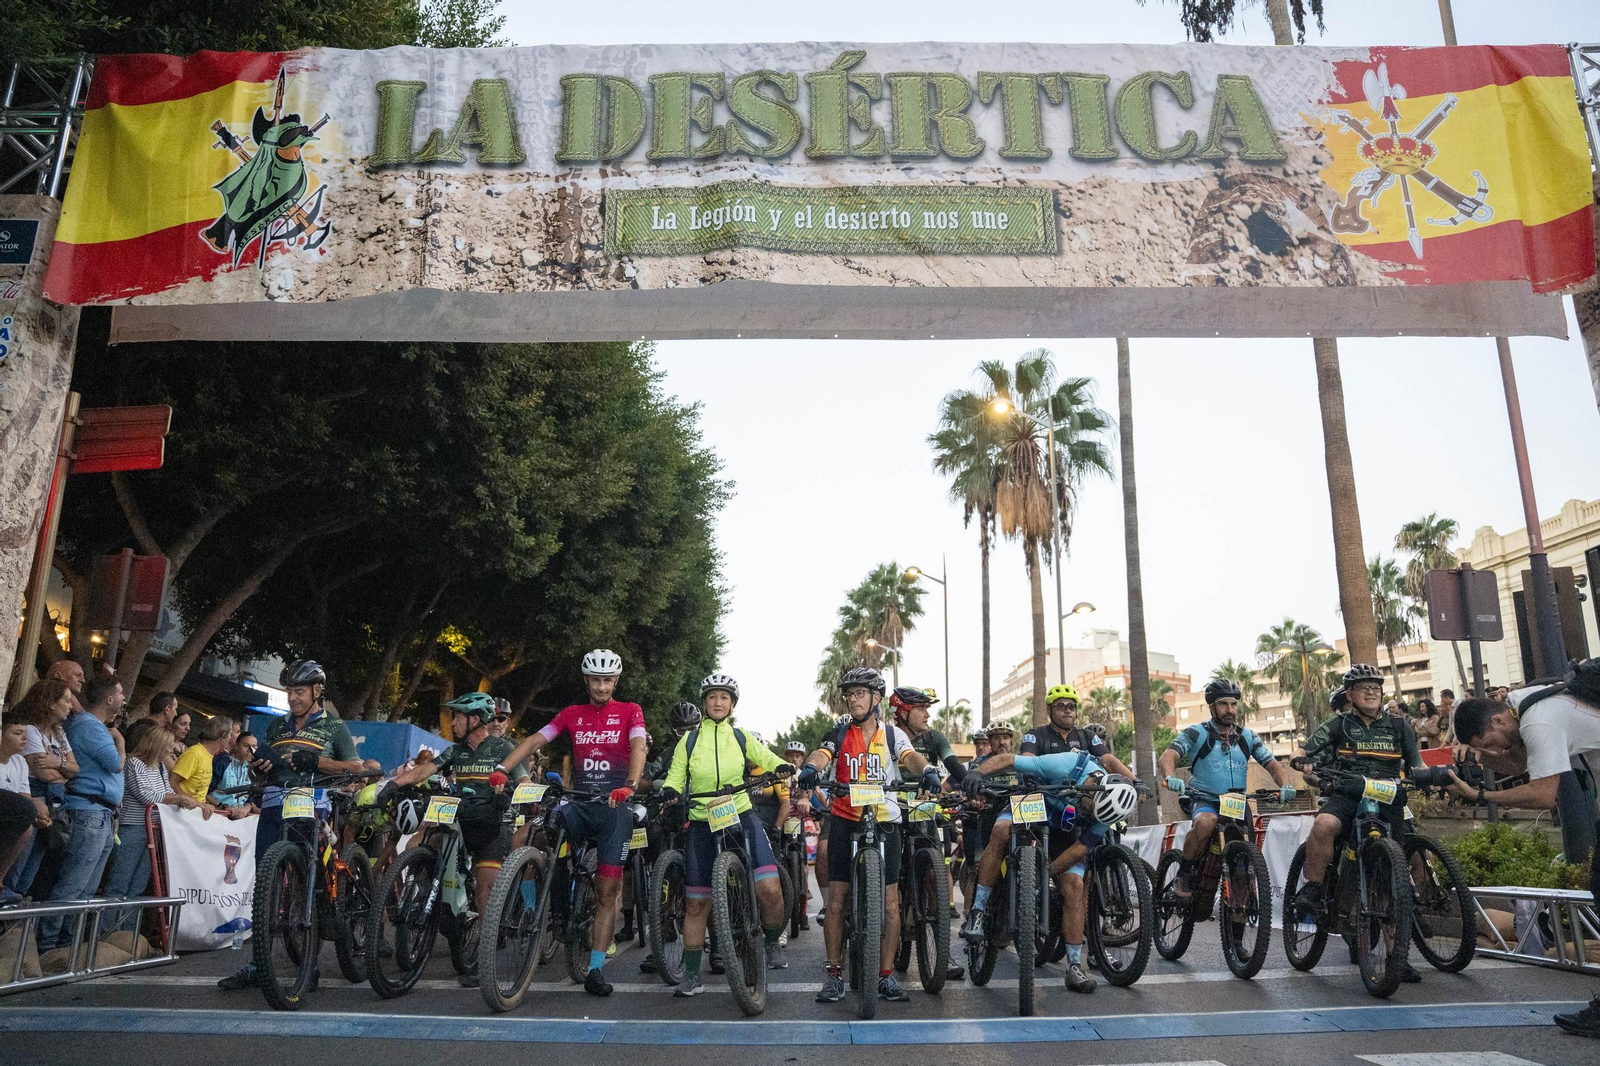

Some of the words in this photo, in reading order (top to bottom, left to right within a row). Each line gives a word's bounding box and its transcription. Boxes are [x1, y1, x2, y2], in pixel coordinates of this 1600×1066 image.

[369, 78, 527, 167] LA
[554, 50, 1288, 162] DESÉRTICA
[651, 206, 678, 230] La
[689, 199, 757, 231] Legión
[769, 208, 783, 231] y
[794, 205, 813, 229] el
[824, 204, 911, 230] desierto
[923, 210, 959, 230] nos
[971, 210, 1009, 230] une
[575, 730, 621, 738] BALDU
[1371, 781, 1396, 795] 10077
[433, 804, 456, 814] 10096
[711, 803, 736, 820] 10030
[1225, 799, 1244, 810] 10139
